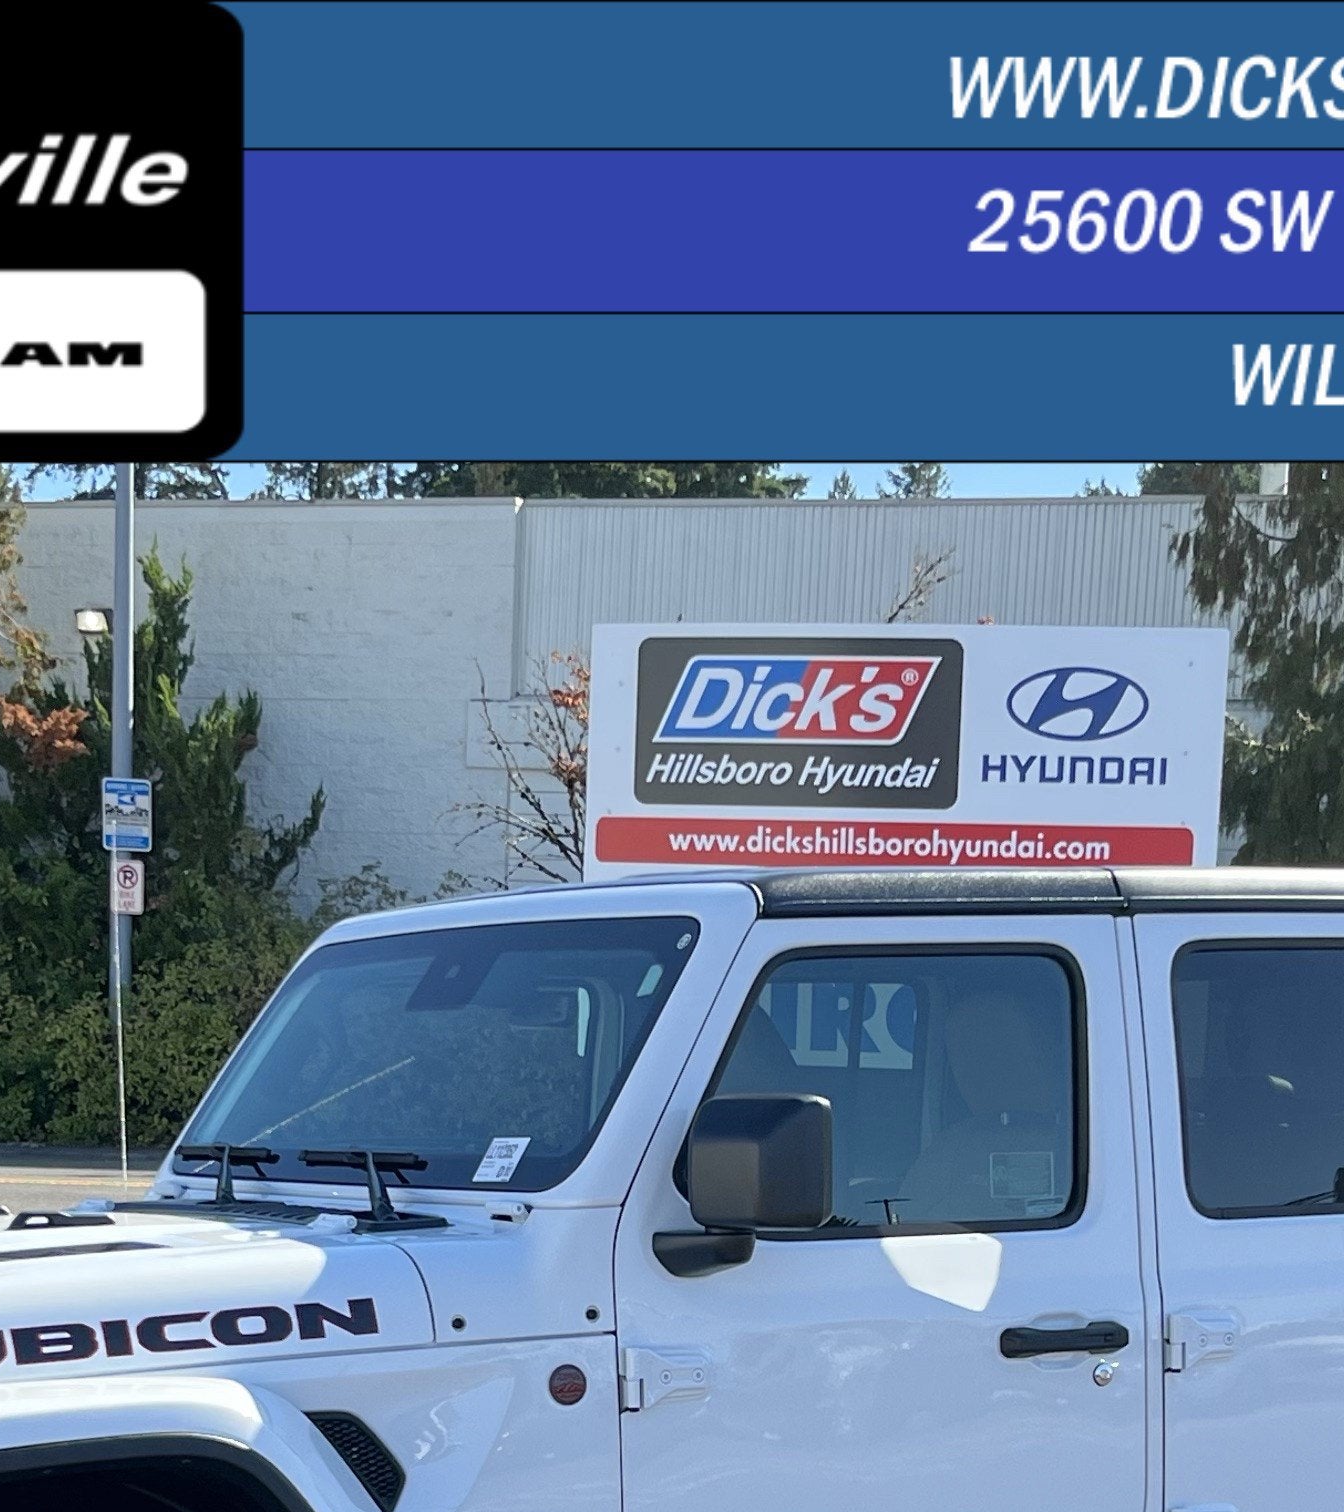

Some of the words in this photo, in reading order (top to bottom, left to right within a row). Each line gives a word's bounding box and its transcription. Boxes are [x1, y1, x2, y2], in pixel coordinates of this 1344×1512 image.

[675, 664, 905, 734] Dick's
[646, 753, 793, 788] Hillsboro
[797, 756, 942, 795] Hyundai
[981, 754, 1168, 787] HYUNDAI
[669, 826, 1111, 865] www.dickshillsborohyundai.com
